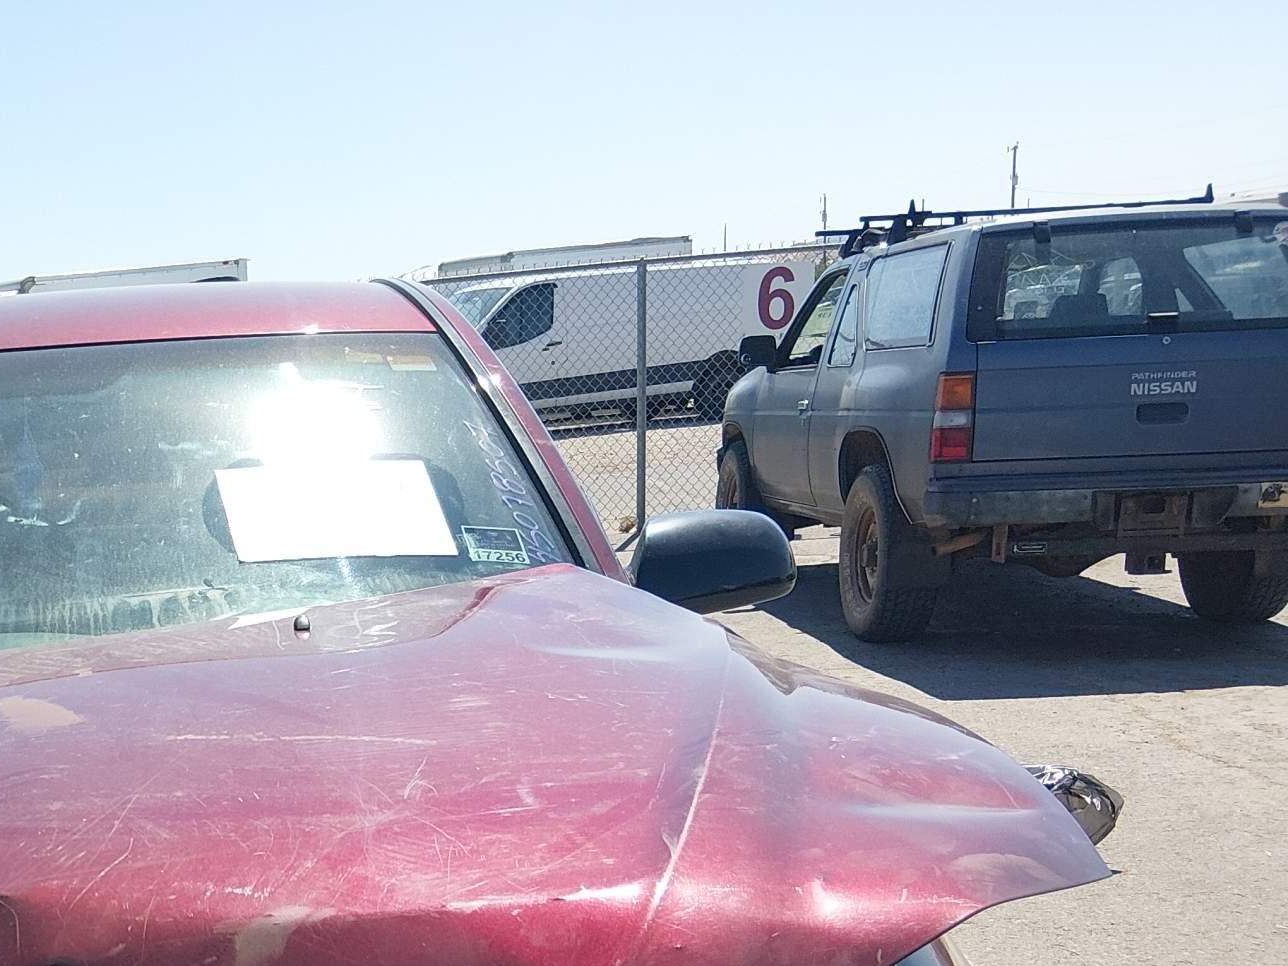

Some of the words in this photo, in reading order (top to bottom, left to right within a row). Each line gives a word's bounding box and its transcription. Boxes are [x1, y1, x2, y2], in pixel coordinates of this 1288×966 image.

[758, 266, 795, 330] 6
[1131, 370, 1197, 380] PATHFINDER
[1130, 381, 1197, 395] NISSAN
[473, 550, 526, 563] 17256
